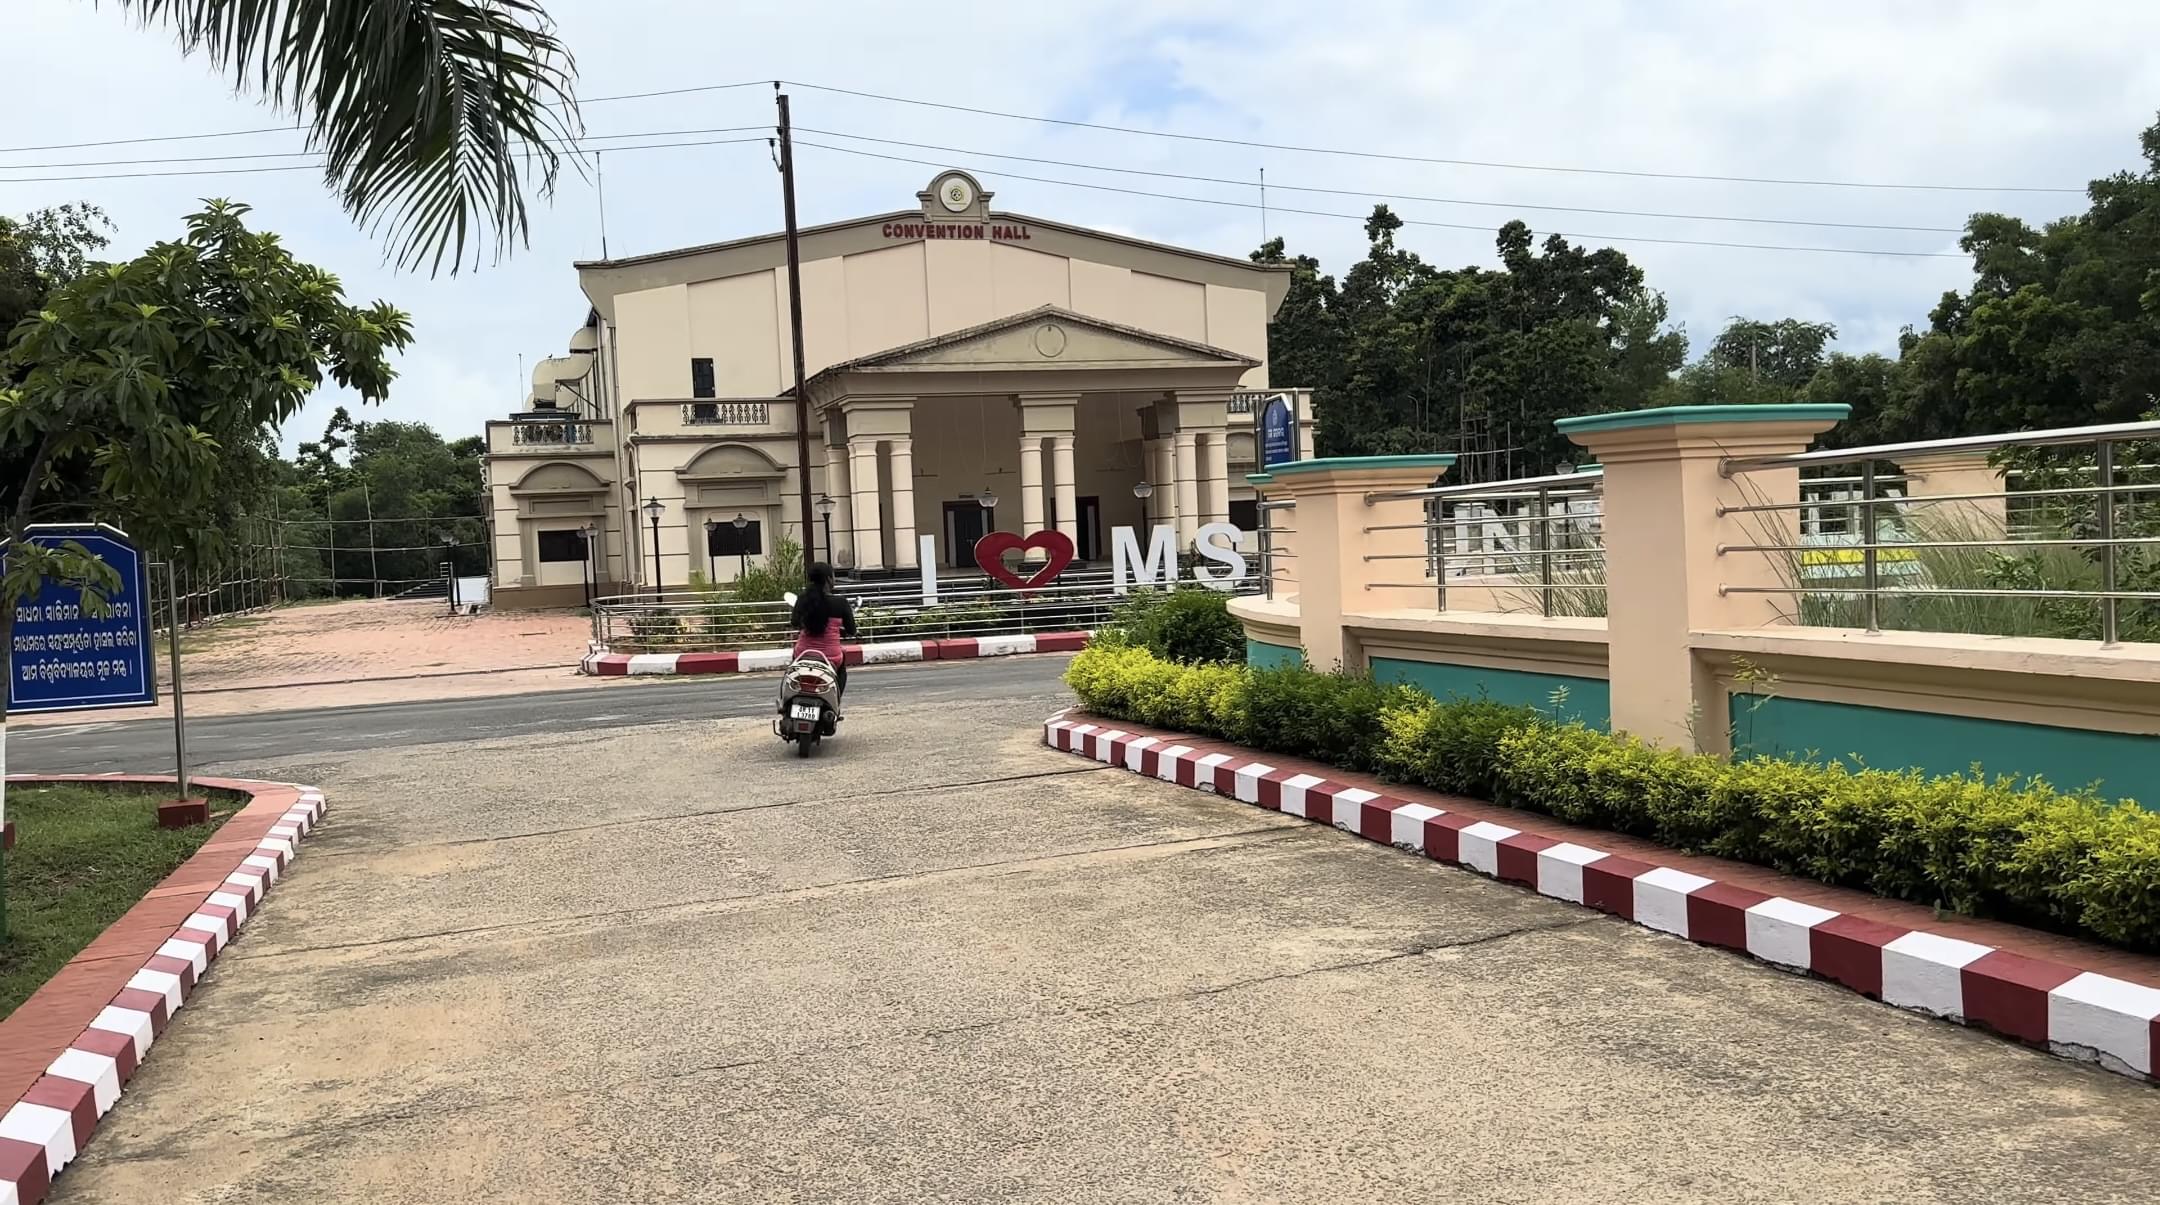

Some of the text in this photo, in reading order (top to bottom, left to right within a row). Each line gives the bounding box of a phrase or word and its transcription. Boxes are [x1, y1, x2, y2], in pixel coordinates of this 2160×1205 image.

[882, 223, 1031, 240] CONVENTION HALL
[919, 534, 938, 606] I
[22, 664, 38, 681] ଆମ
